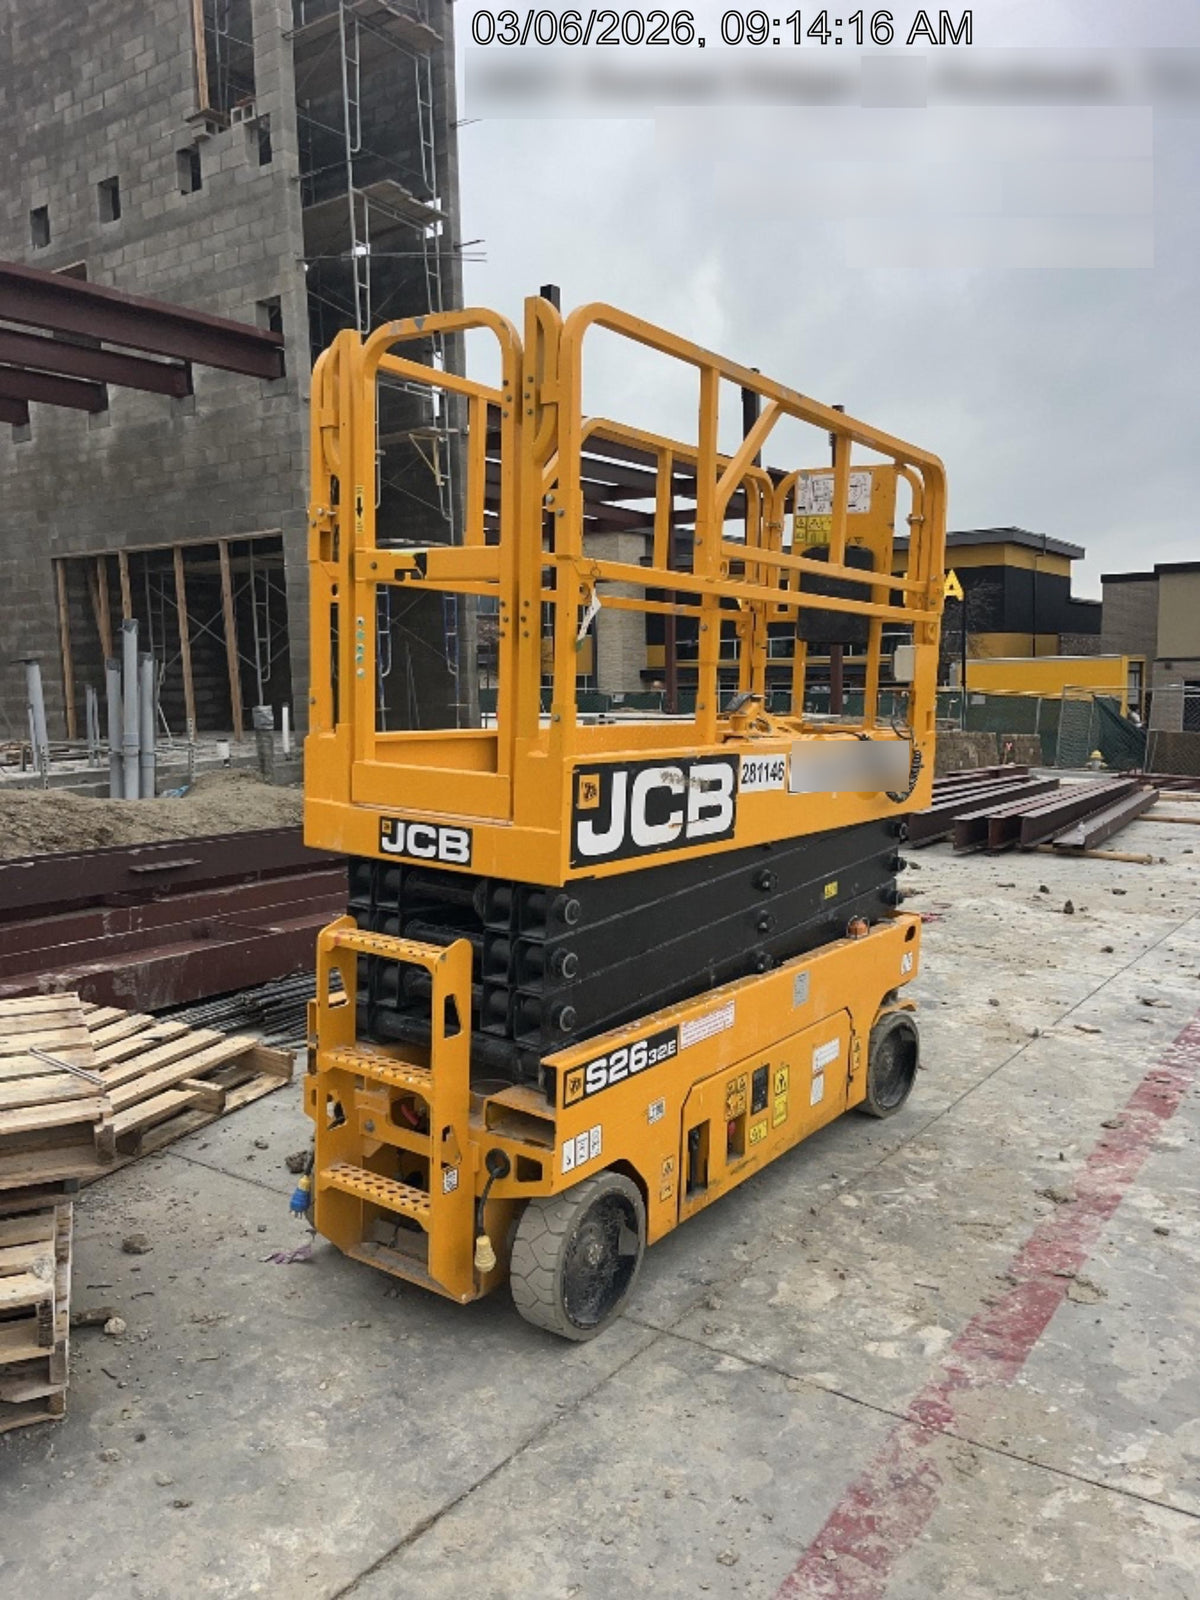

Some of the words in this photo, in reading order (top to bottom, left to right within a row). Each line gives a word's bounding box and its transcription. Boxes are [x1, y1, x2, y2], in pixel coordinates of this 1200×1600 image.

[741, 761, 785, 785] 281146
[577, 762, 735, 856] JCB
[381, 822, 470, 863] JCB
